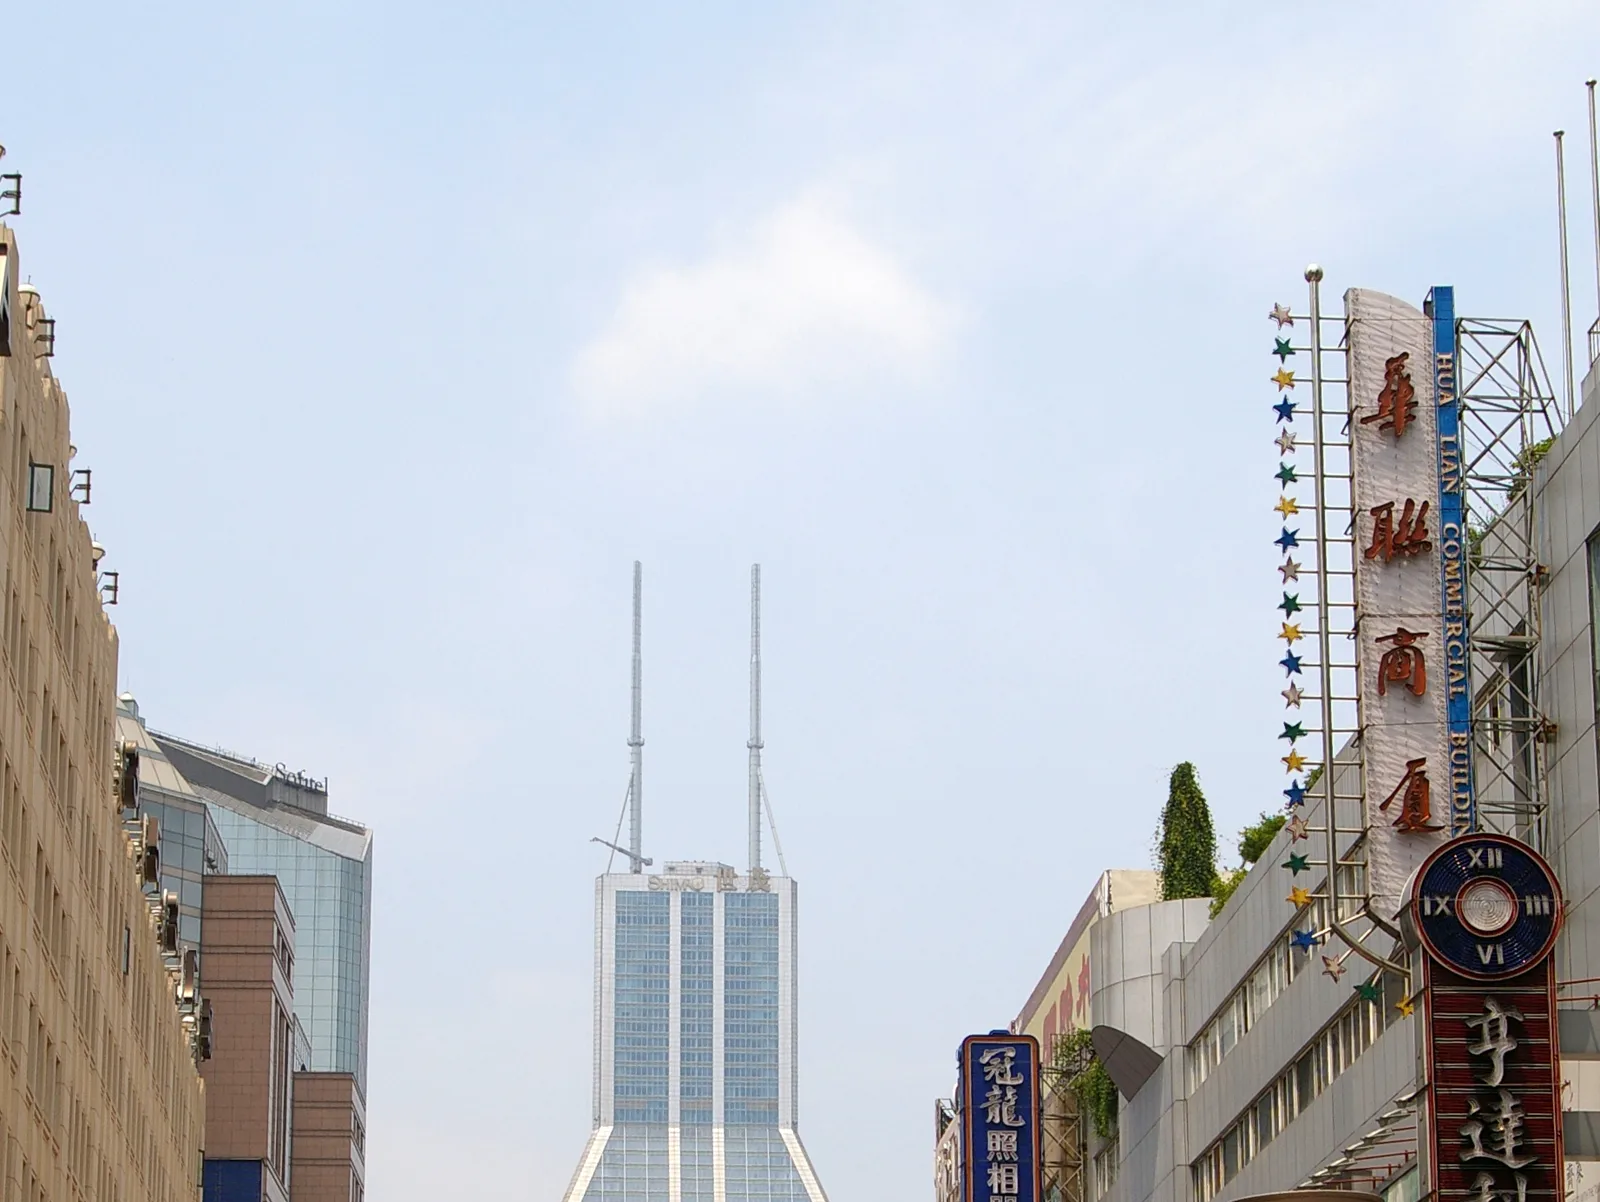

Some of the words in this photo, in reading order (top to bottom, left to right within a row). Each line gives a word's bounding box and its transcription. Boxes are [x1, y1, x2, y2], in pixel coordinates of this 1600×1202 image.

[1436, 352, 1455, 407] HUA
[1440, 434, 1459, 495] LIAN
[1443, 521, 1468, 702] COMMERCIAL
[275, 762, 328, 796] Sofitel
[1450, 731, 1471, 839] BUILDIN
